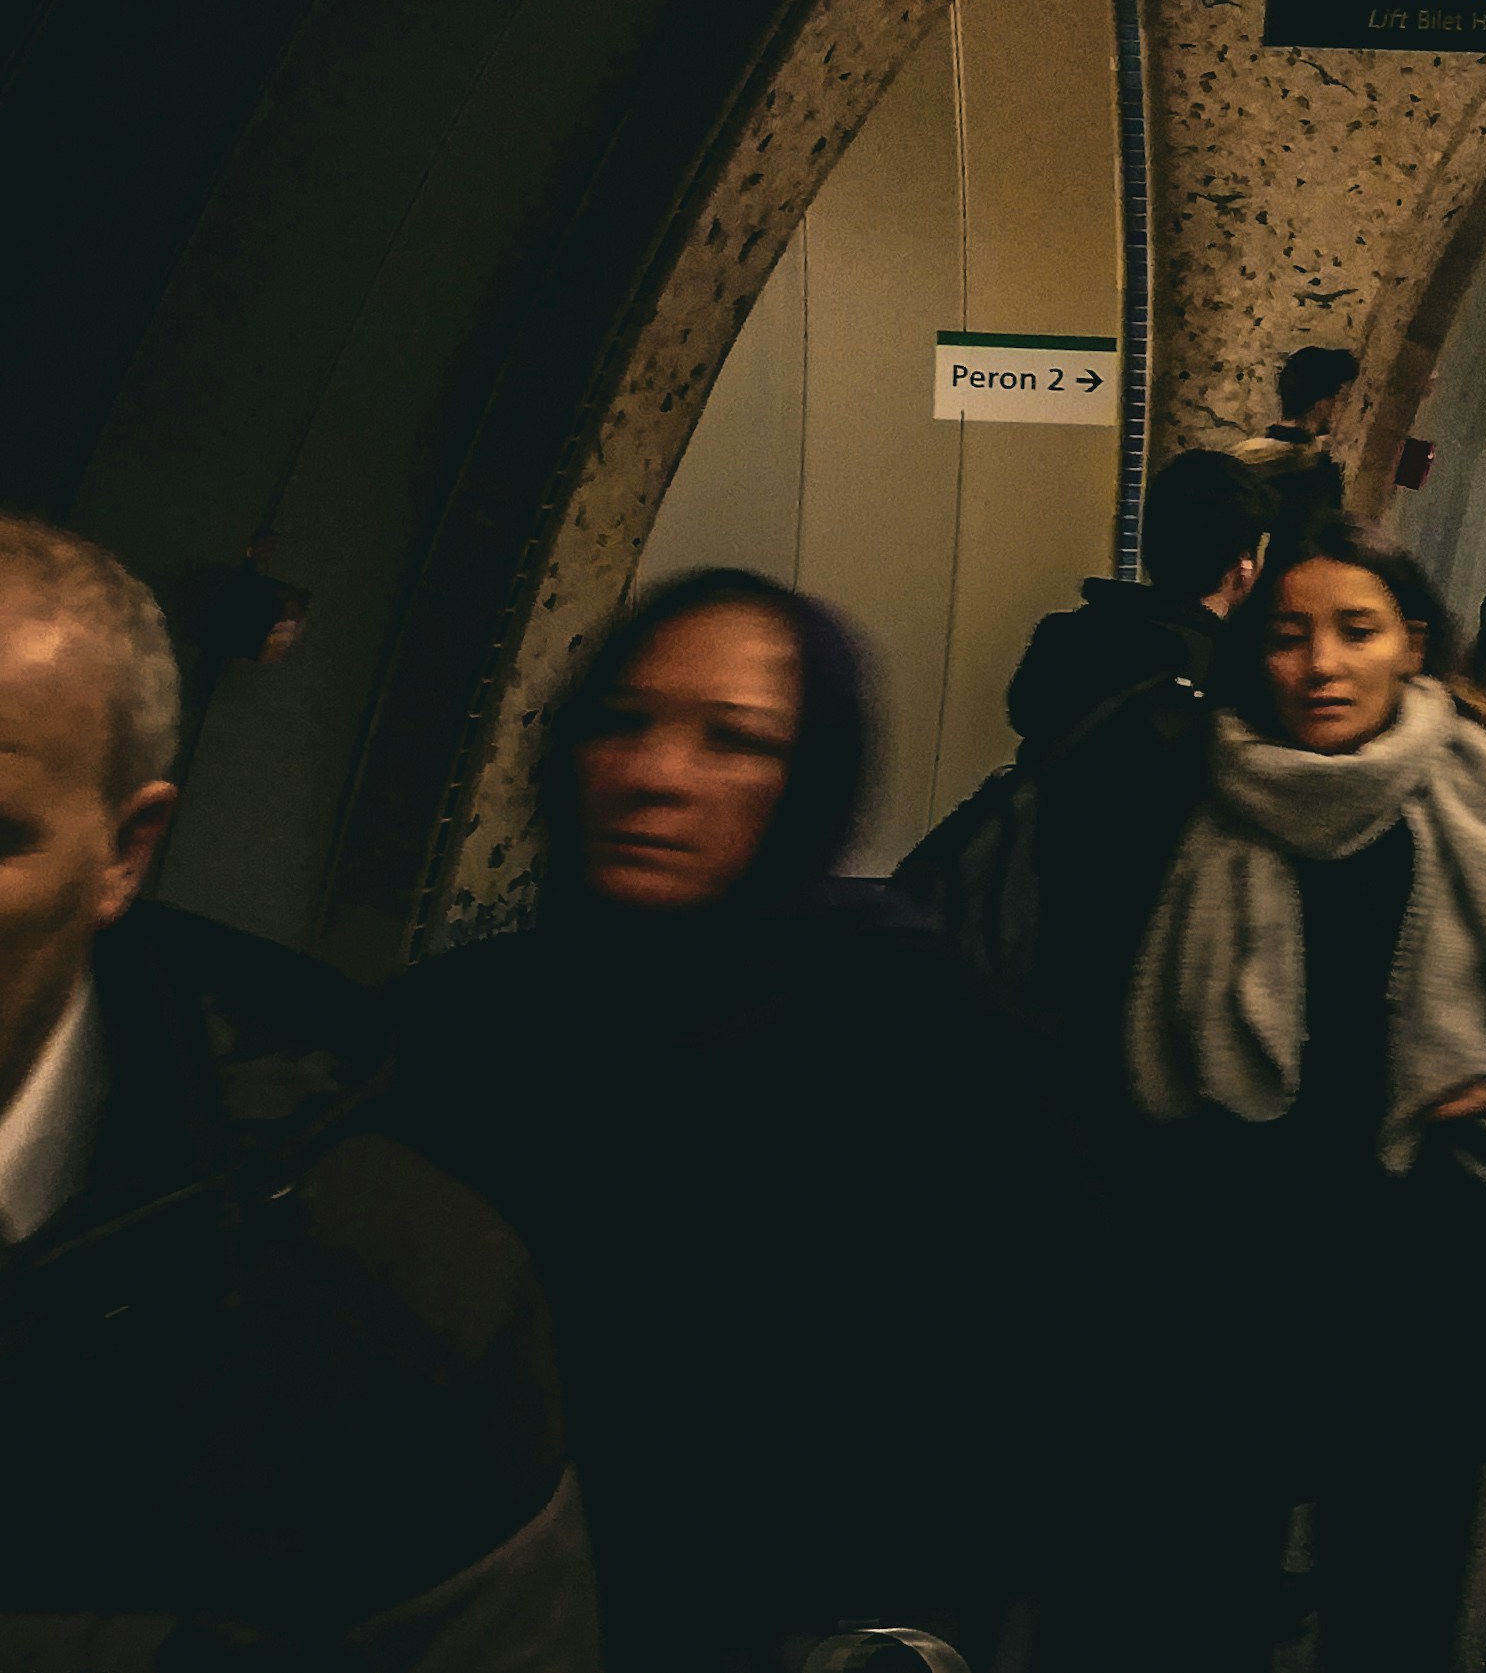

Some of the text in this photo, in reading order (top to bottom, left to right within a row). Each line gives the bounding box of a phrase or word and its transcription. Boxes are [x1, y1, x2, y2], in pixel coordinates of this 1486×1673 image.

[1367, 8, 1409, 30] Lift
[1417, 9, 1464, 32] Bilet
[952, 364, 1065, 391] Peron 2
